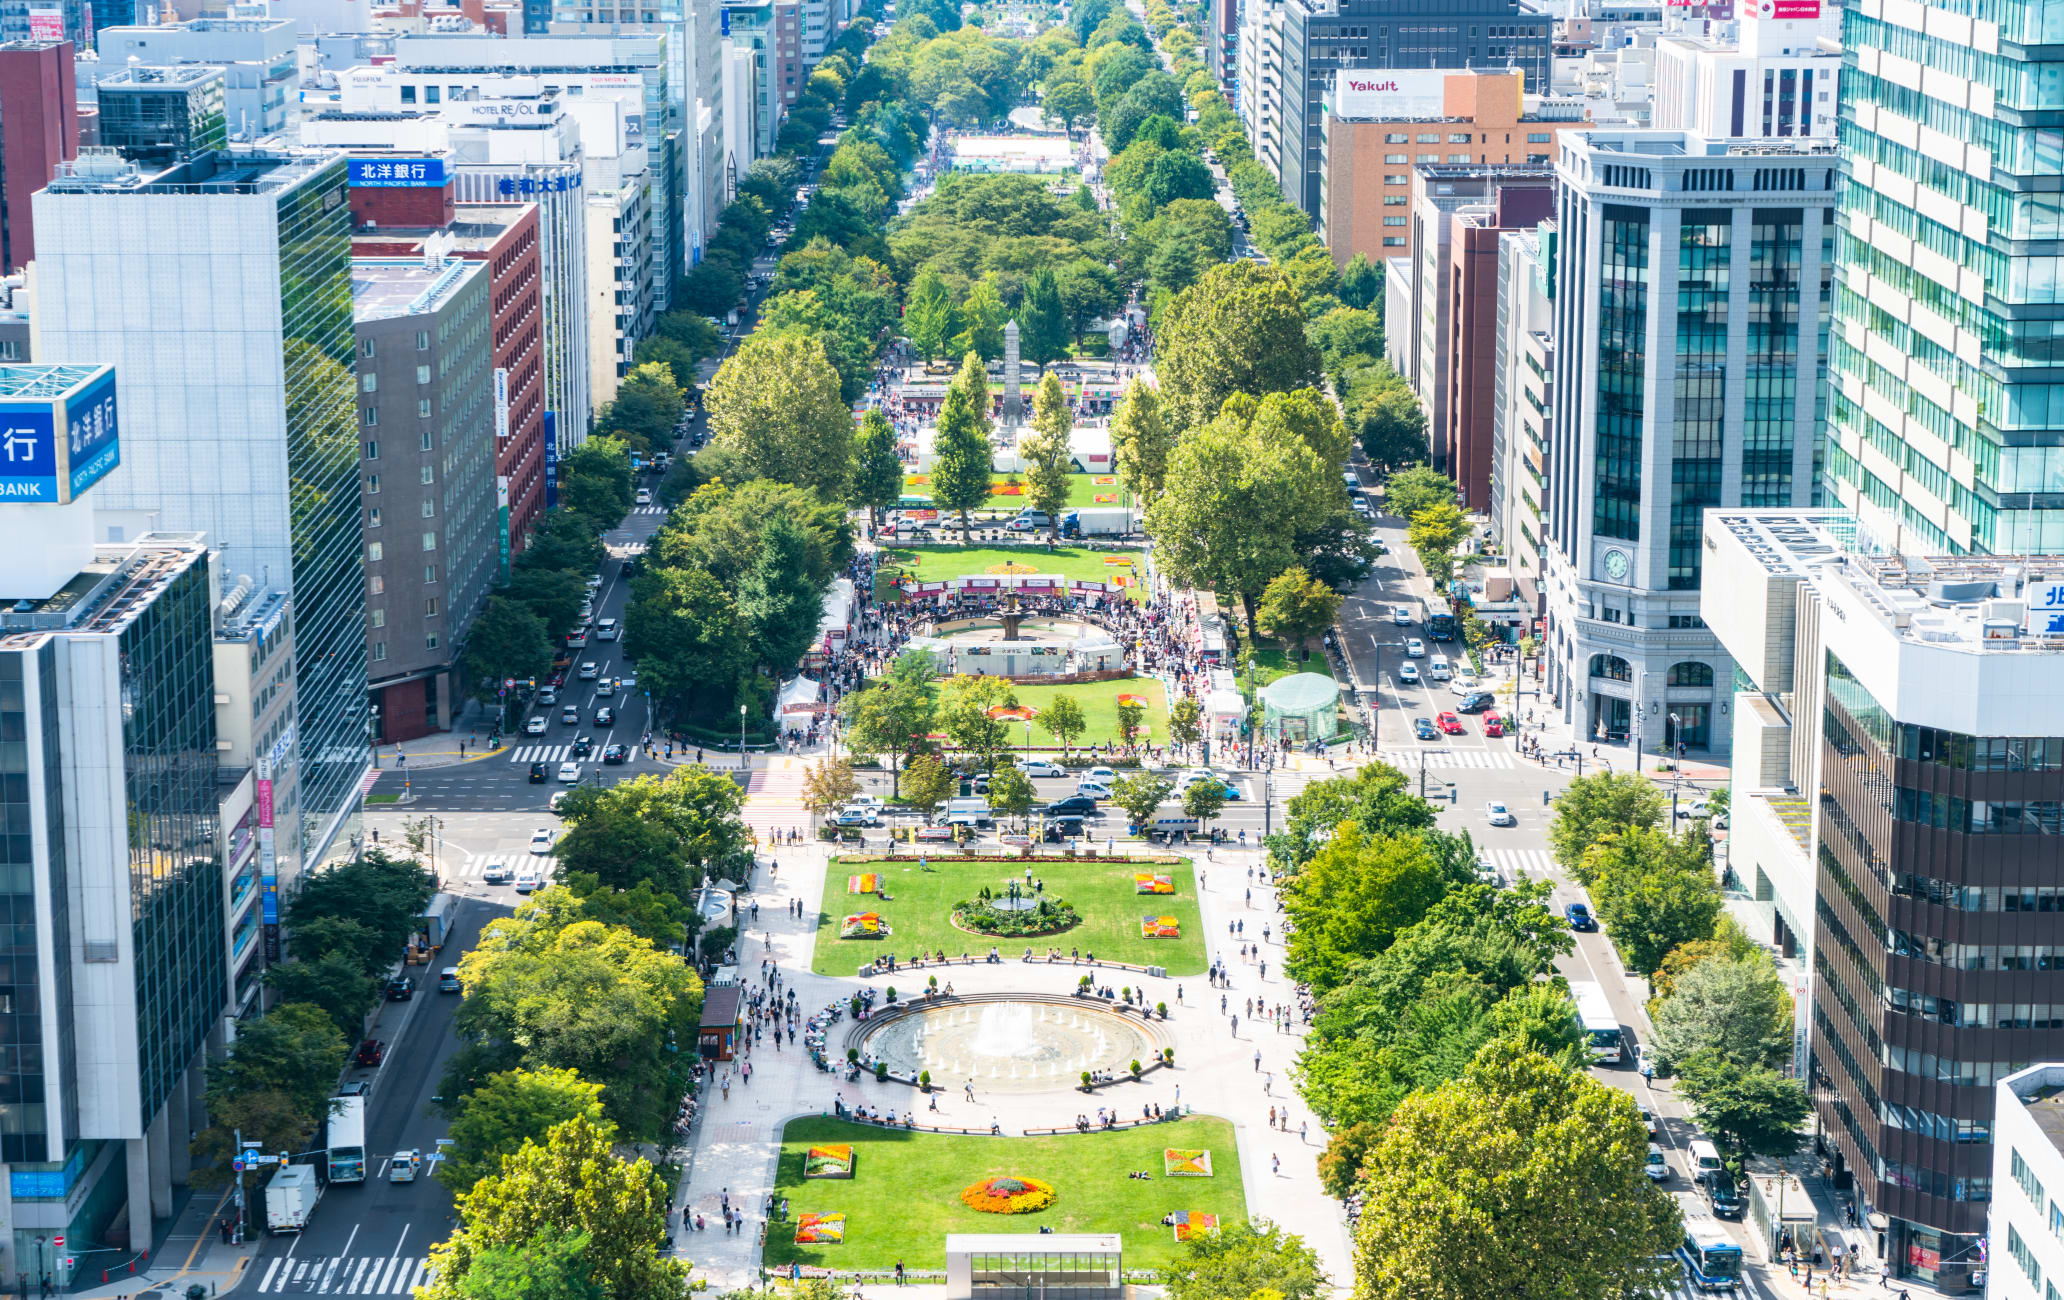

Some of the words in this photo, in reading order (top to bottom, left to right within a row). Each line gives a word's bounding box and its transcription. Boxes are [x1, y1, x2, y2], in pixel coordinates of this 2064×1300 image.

[1349, 81, 1399, 91] Yakult
[472, 106, 499, 115] HOTEL
[361, 163, 426, 179] 北洋銀行
[623, 233, 632, 314] 昭和ビル
[72, 396, 113, 454] 北洋銀行
[3, 427, 38, 461] 行
[546, 442, 556, 487] 北洋銀行
